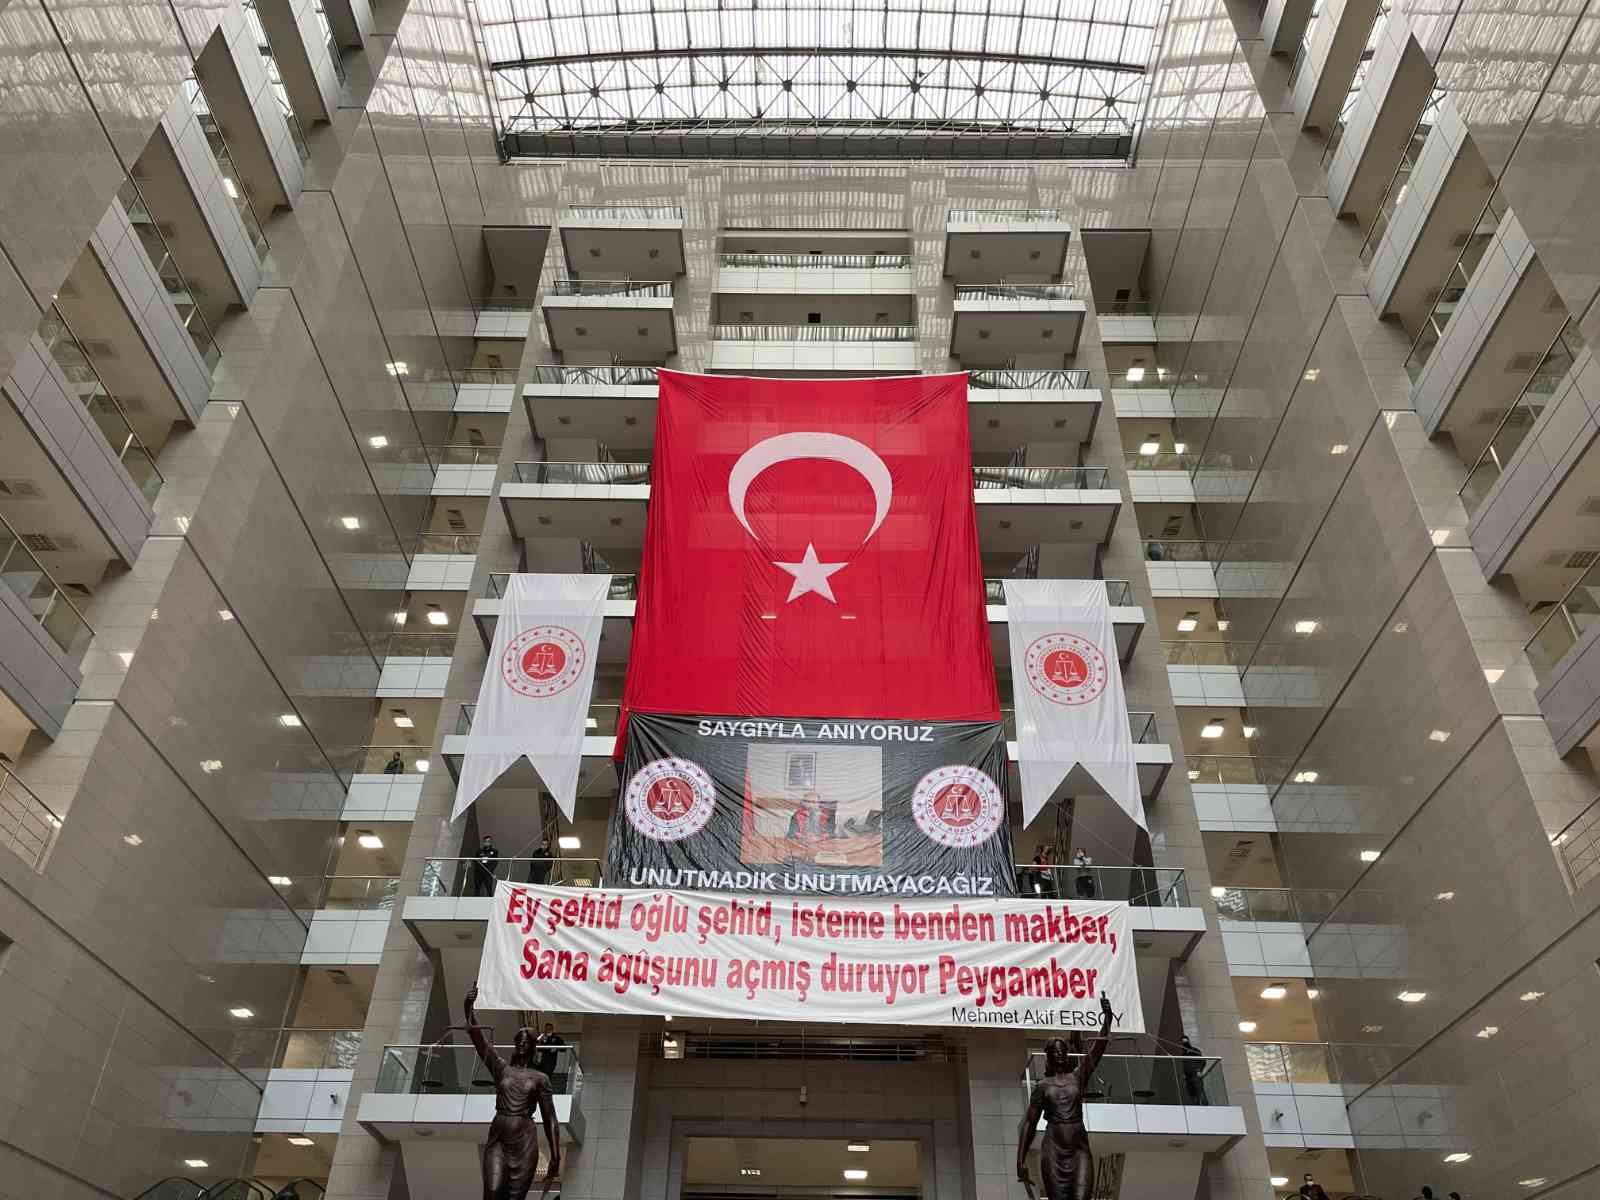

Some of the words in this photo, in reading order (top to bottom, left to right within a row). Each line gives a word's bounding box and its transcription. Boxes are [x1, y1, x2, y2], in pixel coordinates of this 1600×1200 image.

[697, 719, 806, 739] SAYGIYLA
[816, 723, 934, 742] ANIYORUZ
[629, 868, 776, 890] UNUTMADIK
[783, 871, 994, 896] UNUTMAYACAĞIZ
[505, 887, 541, 935] Ey
[546, 891, 623, 936] şehid
[630, 894, 690, 943] oğlu
[697, 898, 783, 945] şehid,
[893, 904, 995, 943] benden
[1004, 905, 1118, 955] makber,
[519, 938, 588, 981] Sana
[726, 957, 812, 1002] açmış
[820, 952, 930, 1005] duruyor
[938, 955, 1098, 1008] Peygamber
[952, 1006, 1020, 1024] Mehmet
[1023, 1008, 1055, 1026] Akif
